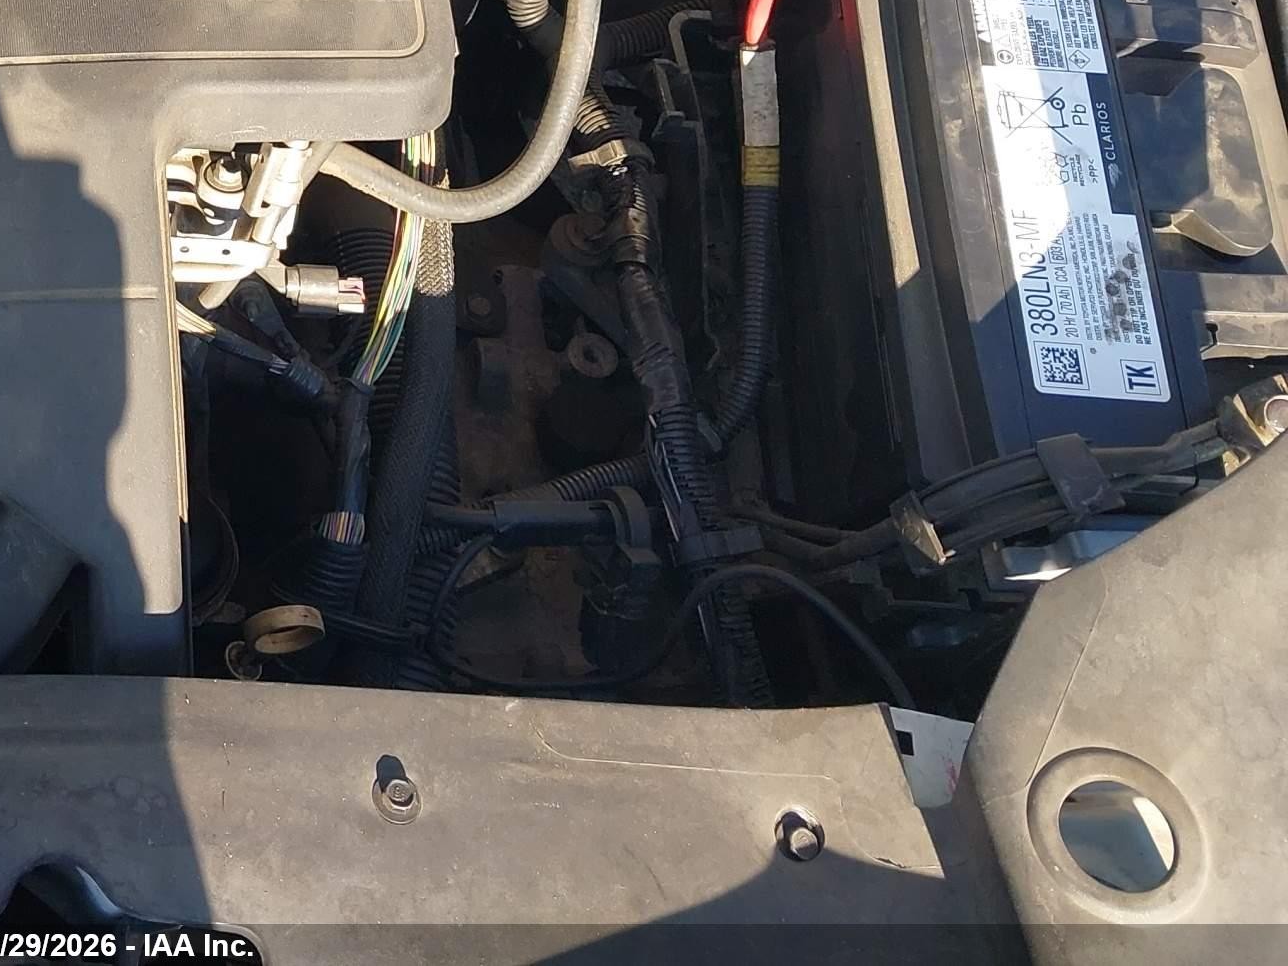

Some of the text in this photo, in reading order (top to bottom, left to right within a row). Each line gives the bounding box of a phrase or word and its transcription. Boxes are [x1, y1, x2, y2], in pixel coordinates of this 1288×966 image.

[1070, 102, 1088, 127] Pb
[1095, 100, 1116, 161] CLARIOS
[1069, 156, 1078, 182] RECYCLE
[1074, 153, 1085, 186] RECYCLAGE
[1086, 157, 1099, 184] >PP<
[1050, 246, 1064, 260] 603
[1009, 209, 1058, 336] 380LN3-MF
[1053, 265, 1067, 282] CCA
[1057, 288, 1070, 299] Ah
[1059, 300, 1072, 310] 70
[1063, 316, 1076, 325] Hr
[1127, 296, 1143, 344] DO NOT TIP OR
[1132, 279, 1151, 344] NE PAS INCLINER OU
[1064, 327, 1078, 338] 20
[1125, 363, 1156, 392] TK
